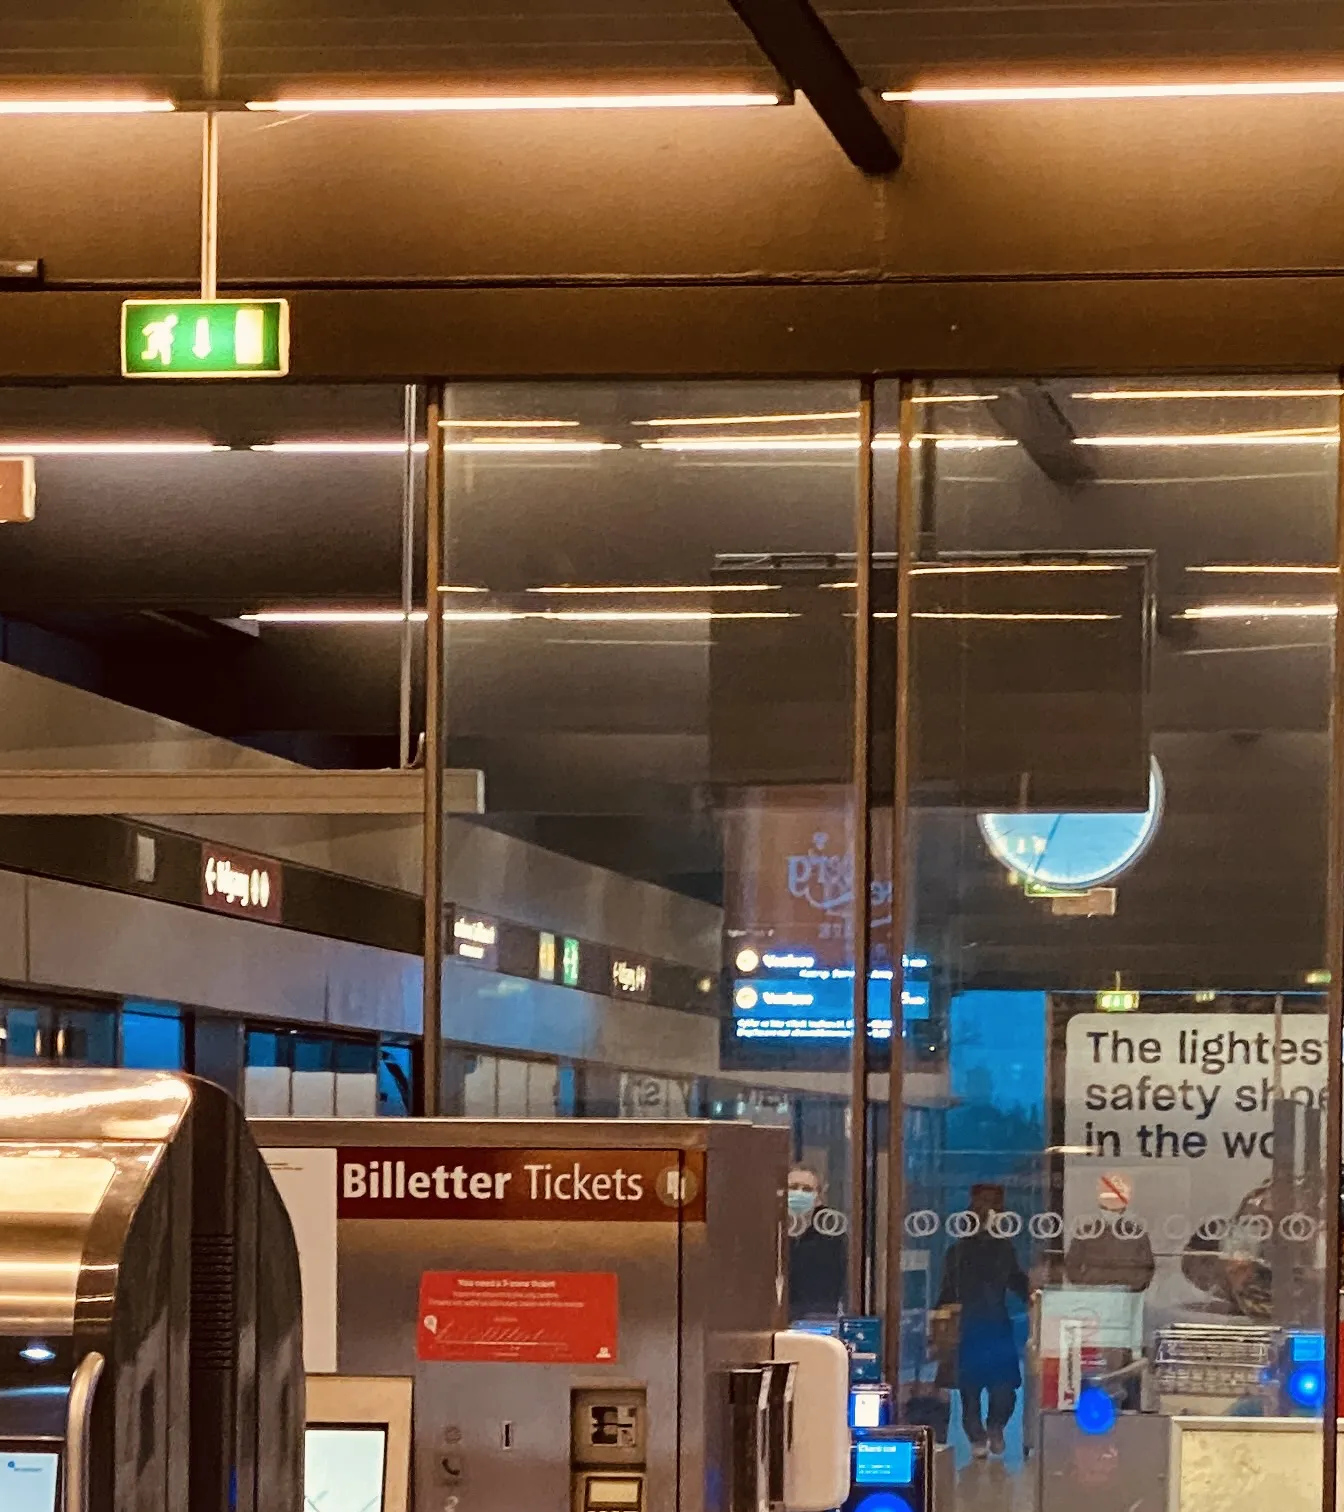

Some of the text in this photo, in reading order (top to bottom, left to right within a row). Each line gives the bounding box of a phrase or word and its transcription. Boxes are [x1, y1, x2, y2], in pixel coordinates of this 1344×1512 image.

[1086, 1029, 1328, 1074] The lightes
[1086, 1075, 1221, 1119] safety
[1085, 1122, 1275, 1158] in the wo
[343, 1161, 644, 1201] Billetter Tickets
